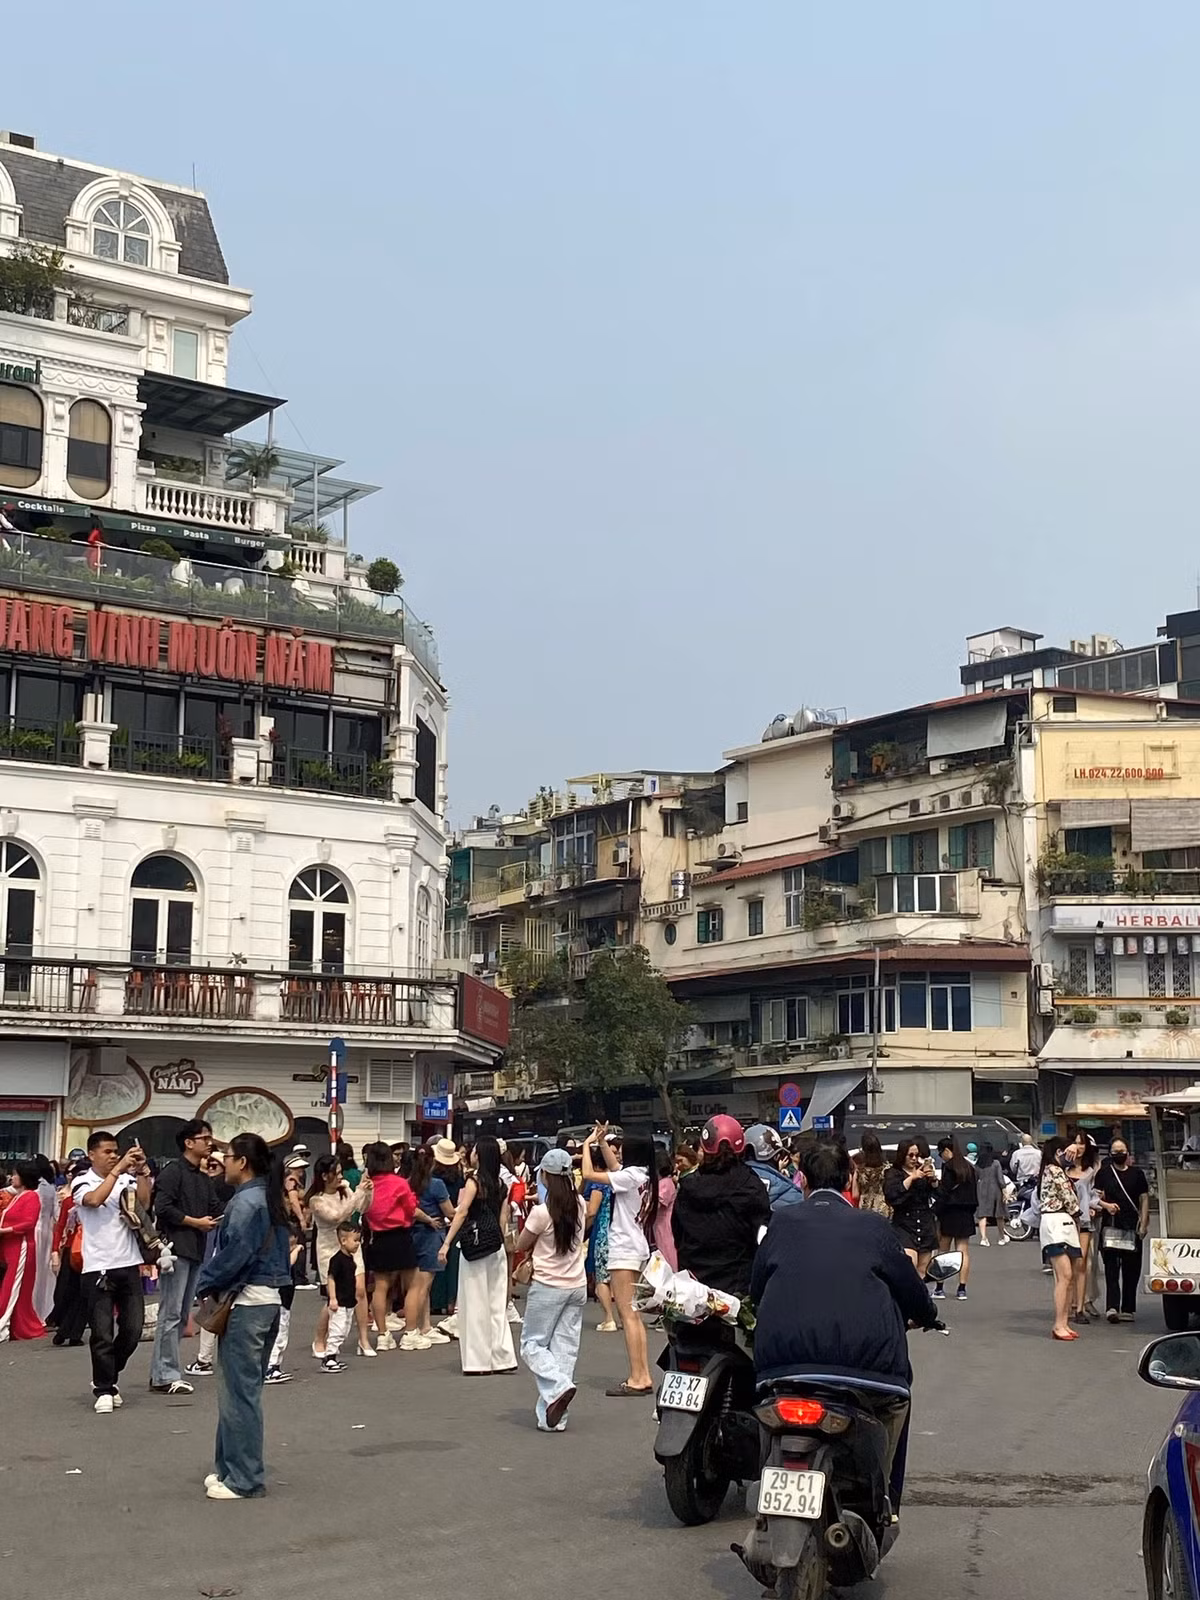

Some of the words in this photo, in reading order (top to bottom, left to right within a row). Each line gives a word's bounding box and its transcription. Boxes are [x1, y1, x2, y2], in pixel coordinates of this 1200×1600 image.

[18, 501, 65, 513] Cocktails
[130, 522, 157, 533] Pizza
[183, 529, 210, 540] Pasta
[234, 536, 265, 548] Burger
[87, 609, 161, 669] VINH
[168, 615, 257, 683] MUÔN
[265, 624, 334, 693] NĂM
[1116, 915, 1200, 927] HERBAL
[668, 1374, 702, 1392] 29-X7
[661, 1390, 700, 1408] 463.84
[769, 1471, 814, 1493] 29-C1
[763, 1491, 817, 1515] 952.94
